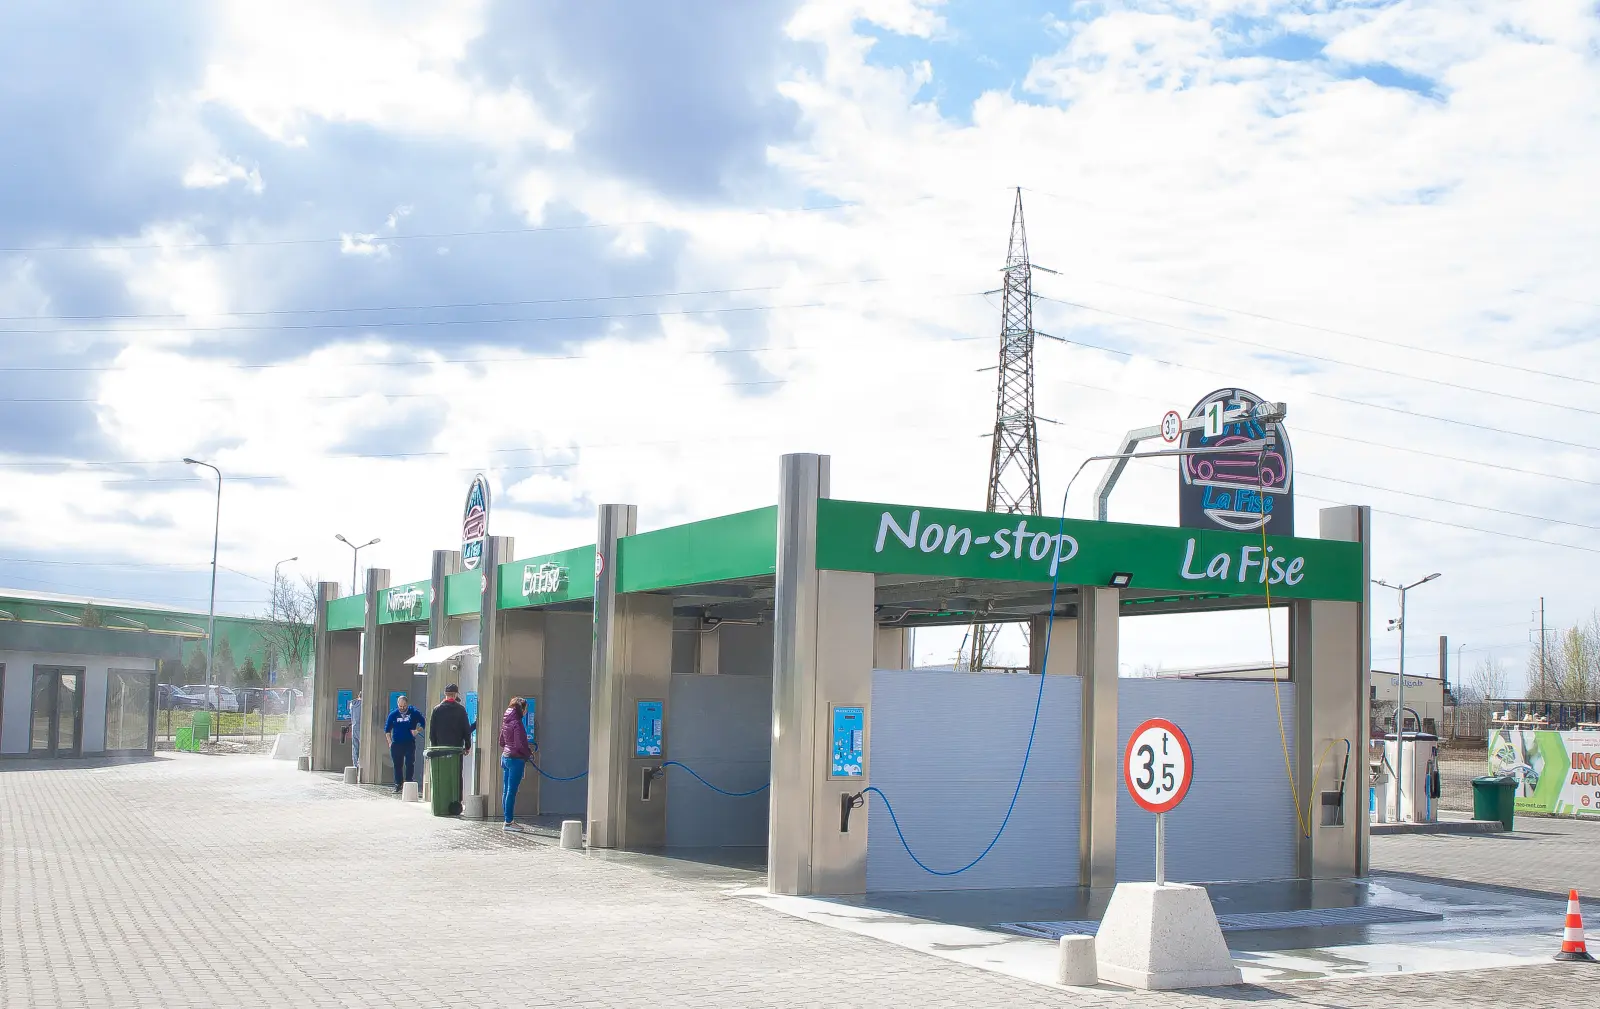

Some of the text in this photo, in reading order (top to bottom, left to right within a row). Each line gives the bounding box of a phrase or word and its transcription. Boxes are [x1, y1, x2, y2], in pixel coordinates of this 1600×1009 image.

[1208, 404, 1218, 435] 1
[1202, 486, 1274, 514] La Fise
[875, 510, 1079, 577] Non-stop
[1181, 537, 1305, 586] La Fise
